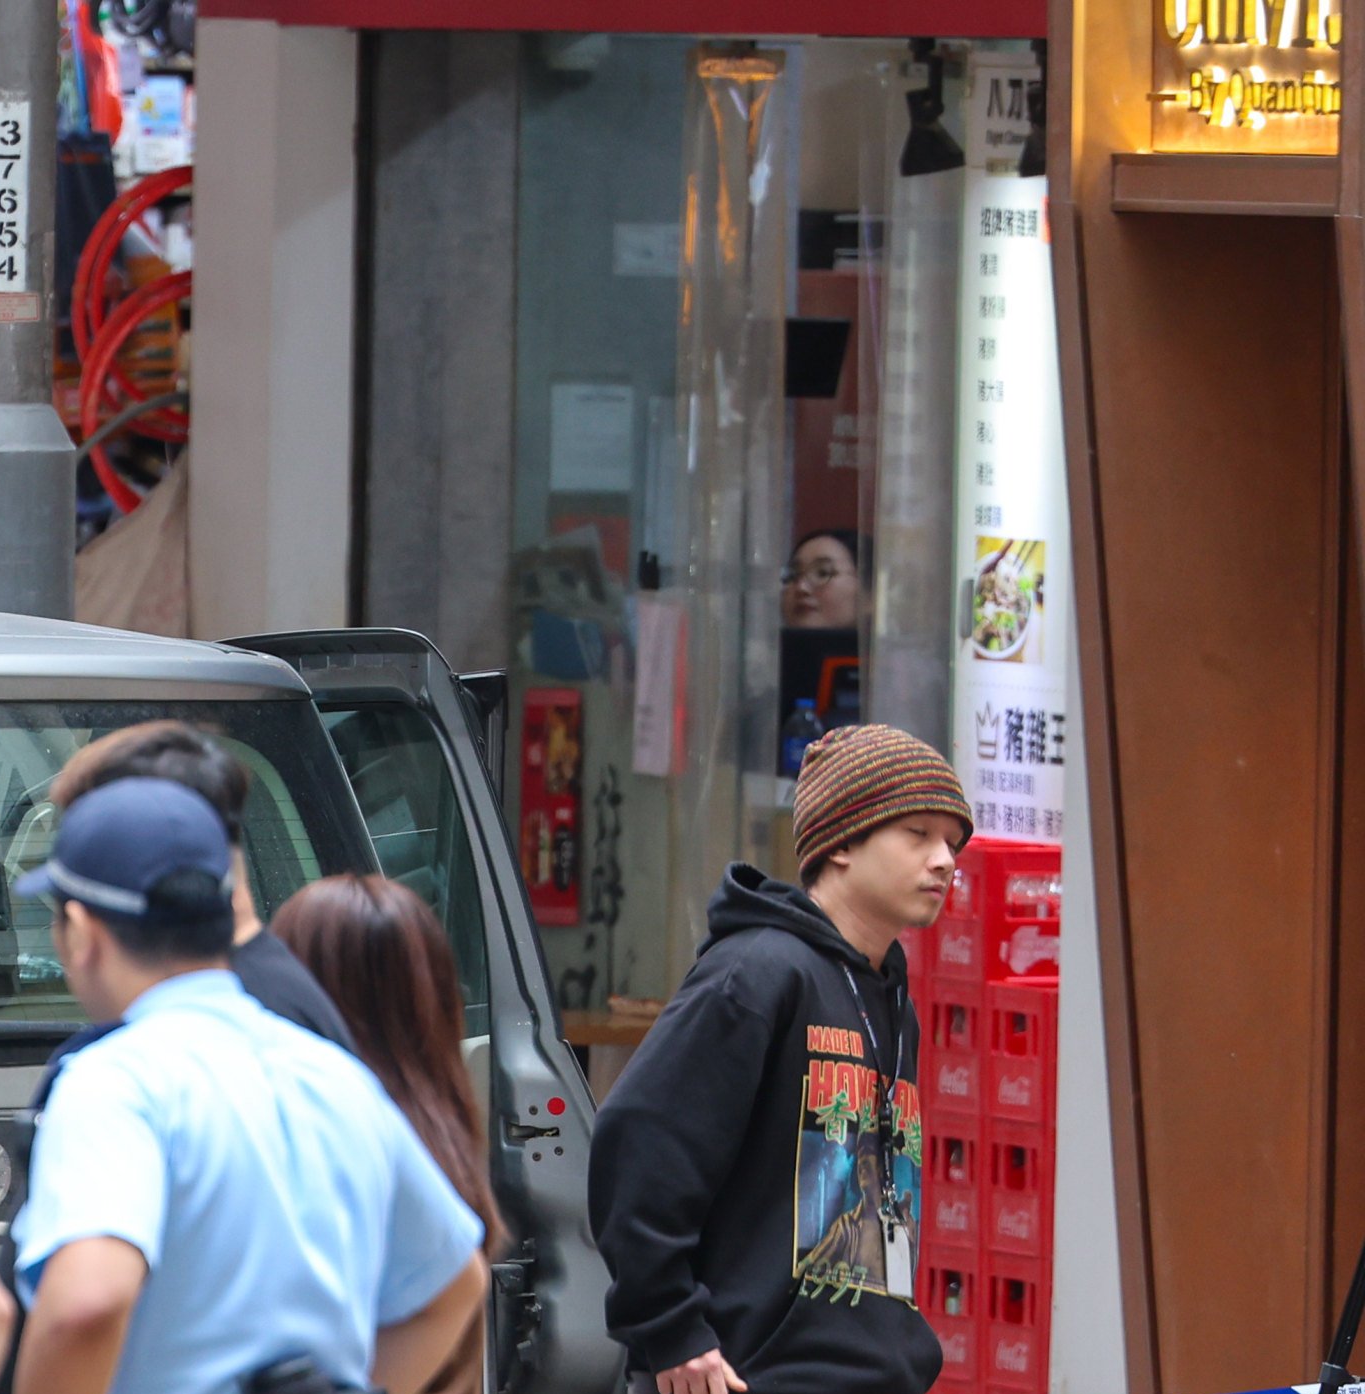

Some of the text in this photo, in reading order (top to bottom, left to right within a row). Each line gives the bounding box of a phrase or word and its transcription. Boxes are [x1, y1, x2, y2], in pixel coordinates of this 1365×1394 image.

[1189, 68, 1229, 125] By
[807, 1024, 864, 1059] MADE IN
